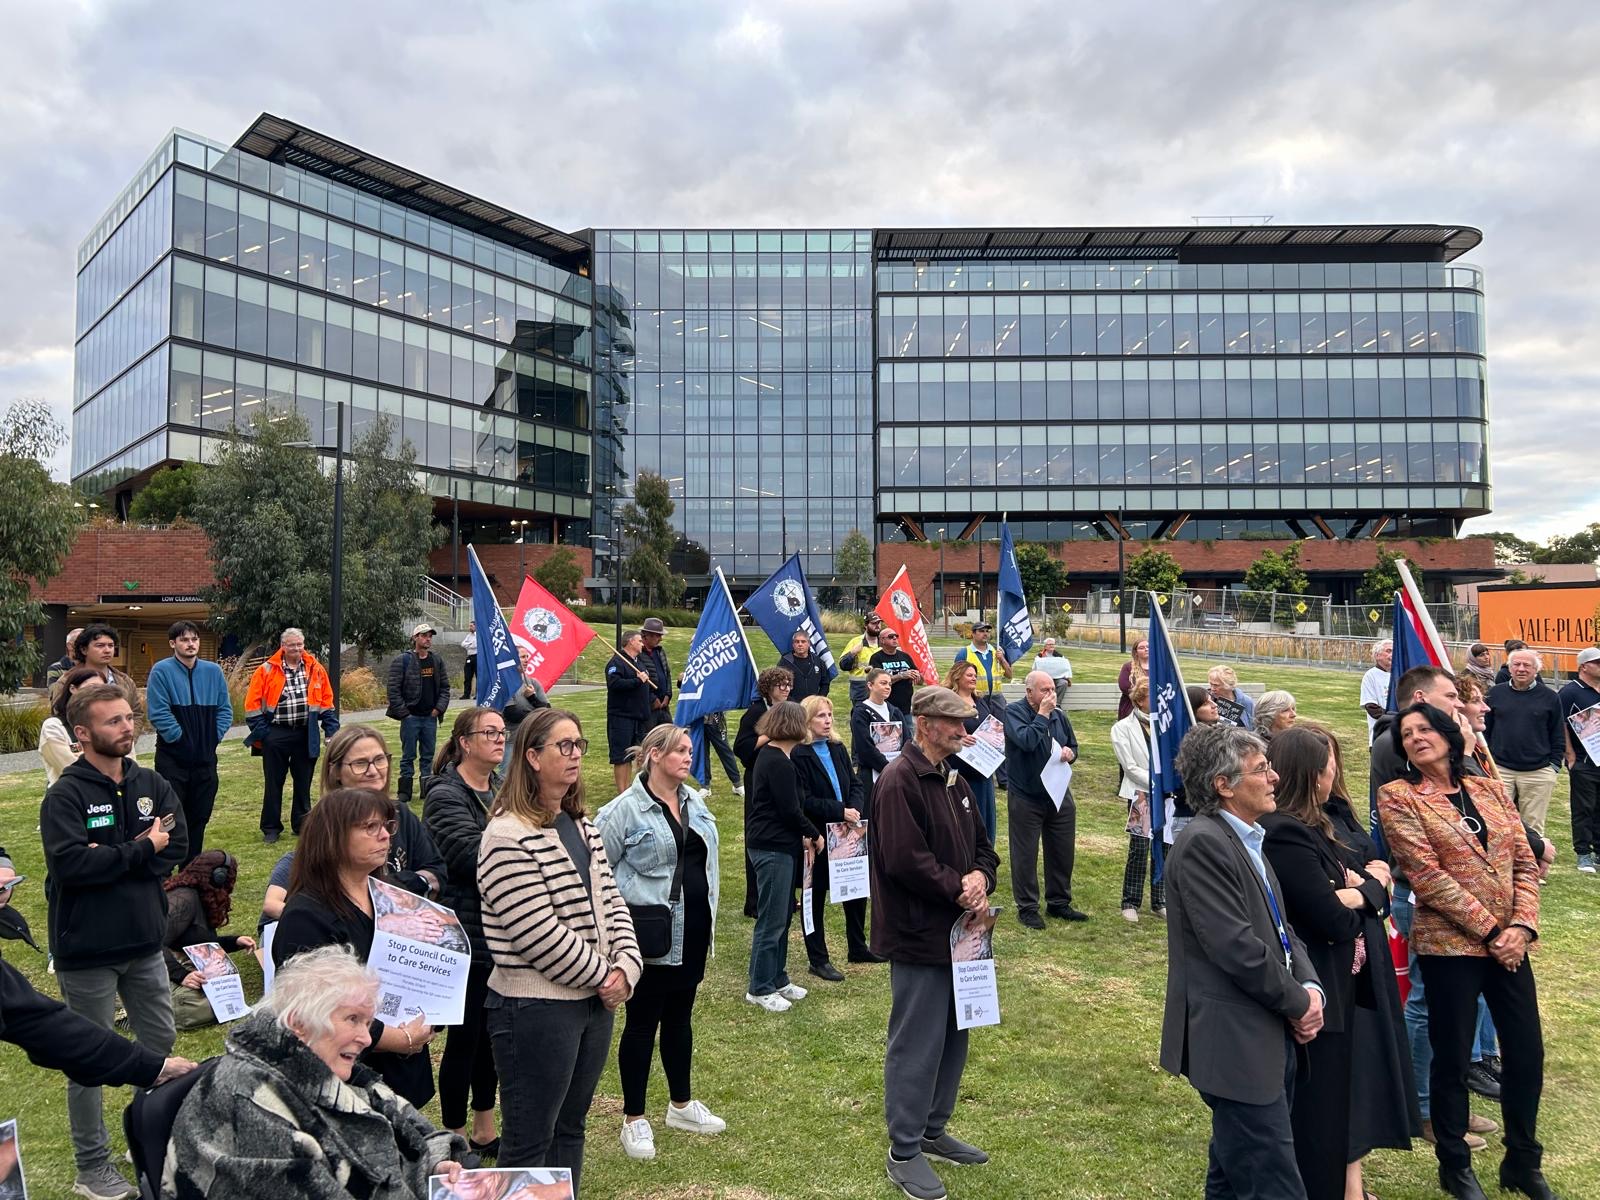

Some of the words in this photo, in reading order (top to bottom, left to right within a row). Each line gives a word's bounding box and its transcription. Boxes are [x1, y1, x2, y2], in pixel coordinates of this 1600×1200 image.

[882, 660, 910, 670] MUA
[87, 804, 113, 814] Jeep
[91, 816, 110, 828] nib
[388, 939, 407, 952] Stop
[409, 946, 438, 960] Council
[440, 954, 457, 966] Cuts
[388, 953, 397, 962] to
[398, 956, 417, 968] Care
[418, 962, 452, 977] Services
